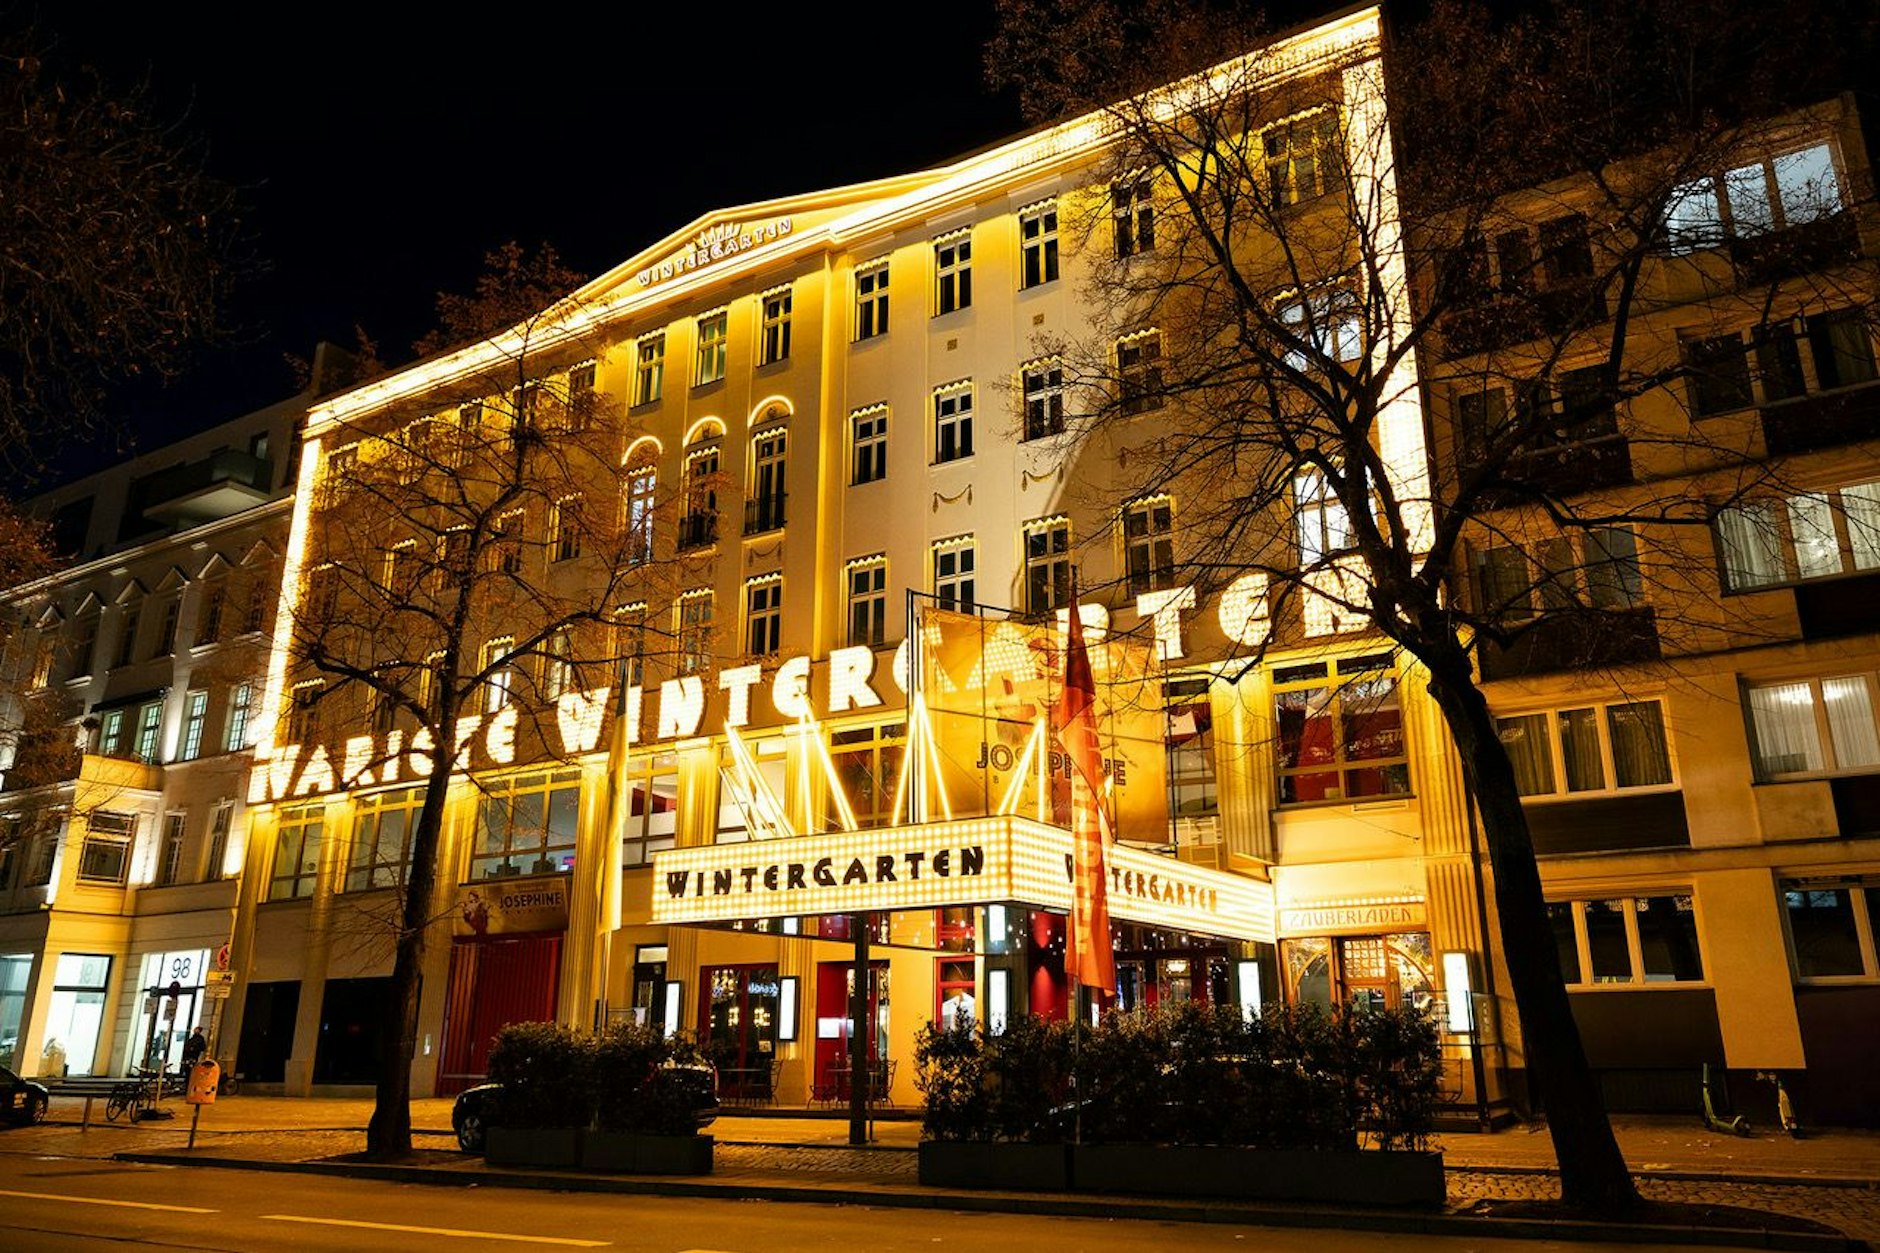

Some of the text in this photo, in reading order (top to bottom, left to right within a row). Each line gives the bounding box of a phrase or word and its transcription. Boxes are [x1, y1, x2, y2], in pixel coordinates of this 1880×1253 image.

[636, 217, 793, 287] WINTERGARTEN
[666, 846, 985, 899] WINTERGARTEN
[1064, 853, 1217, 912] TERGARTEN
[499, 892, 561, 909] JOSEPHINE
[1290, 907, 1412, 928] ZAUBERLADEN
[171, 957, 191, 979] 98
